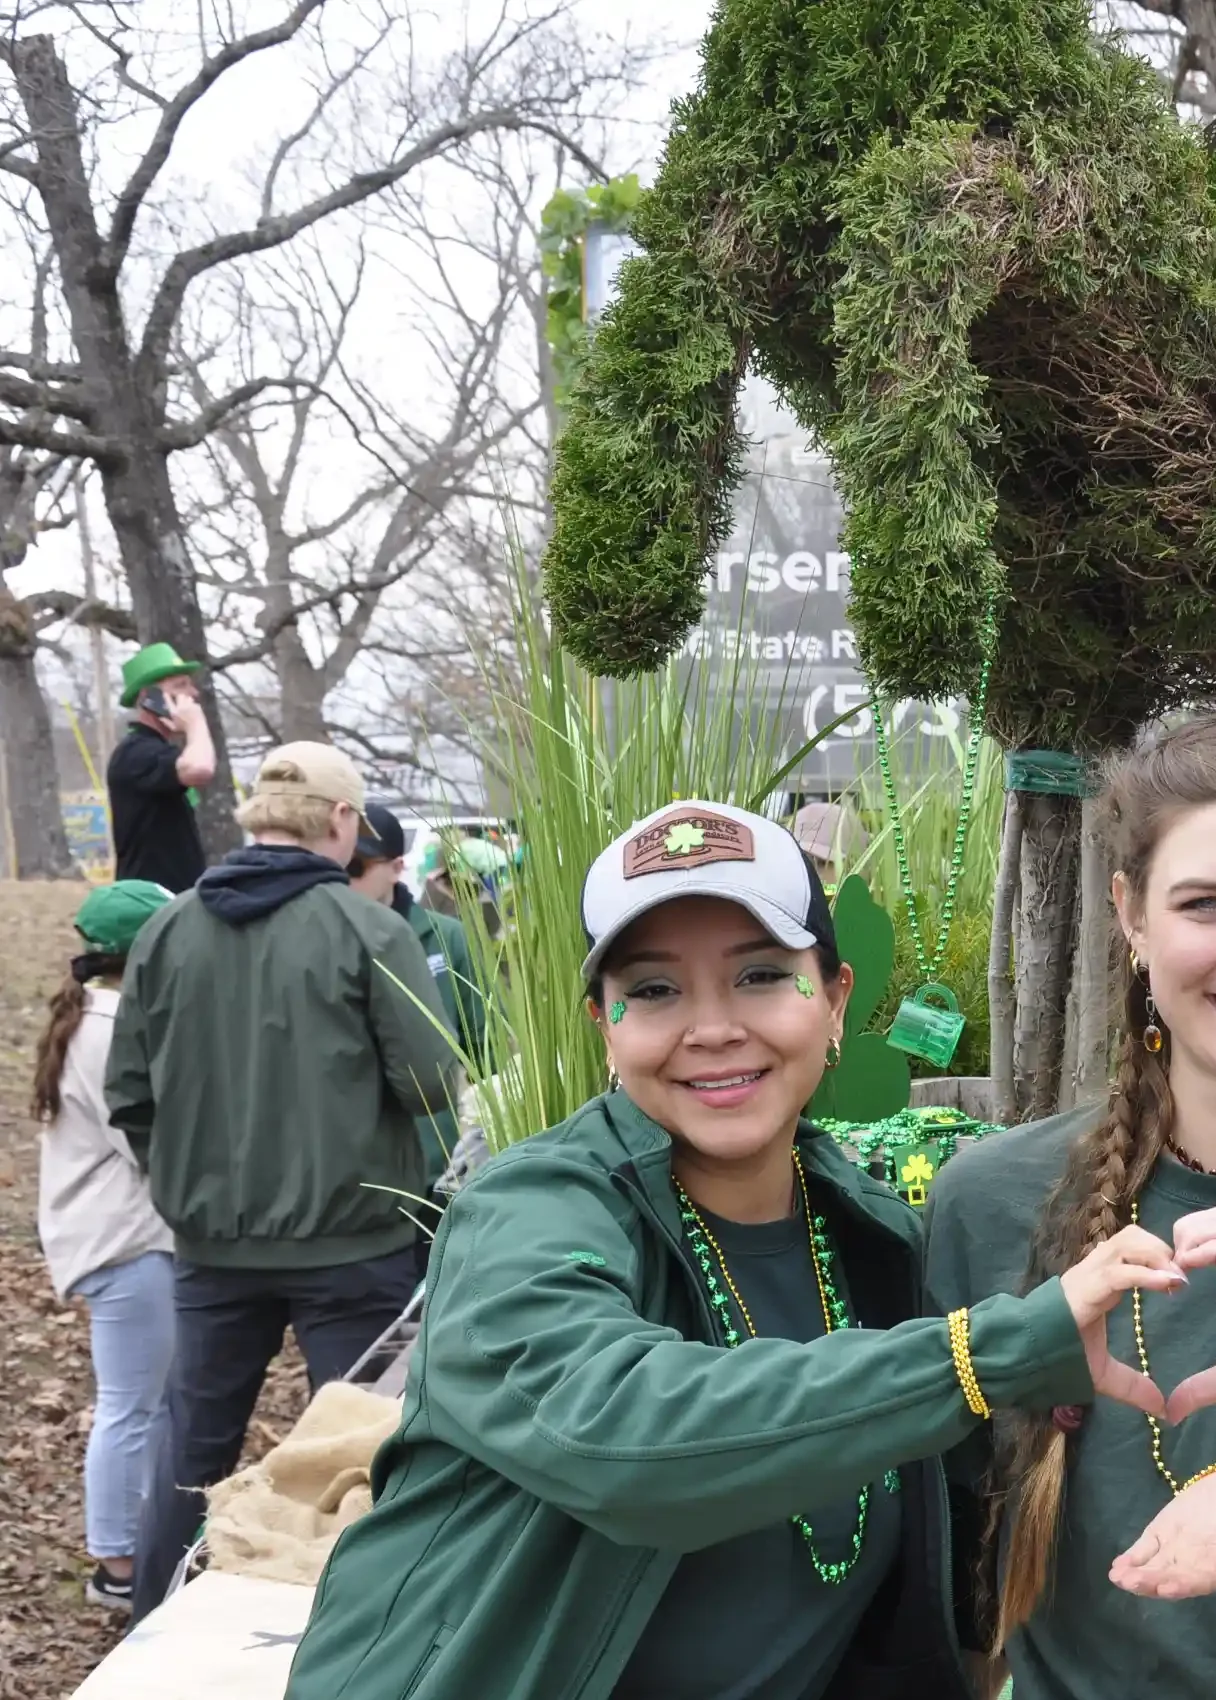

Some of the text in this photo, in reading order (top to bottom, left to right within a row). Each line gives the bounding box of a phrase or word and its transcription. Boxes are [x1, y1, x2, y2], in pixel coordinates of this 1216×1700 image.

[721, 629, 826, 660] State
[831, 629, 858, 659] R
[636, 818, 741, 850] DOOR'S
